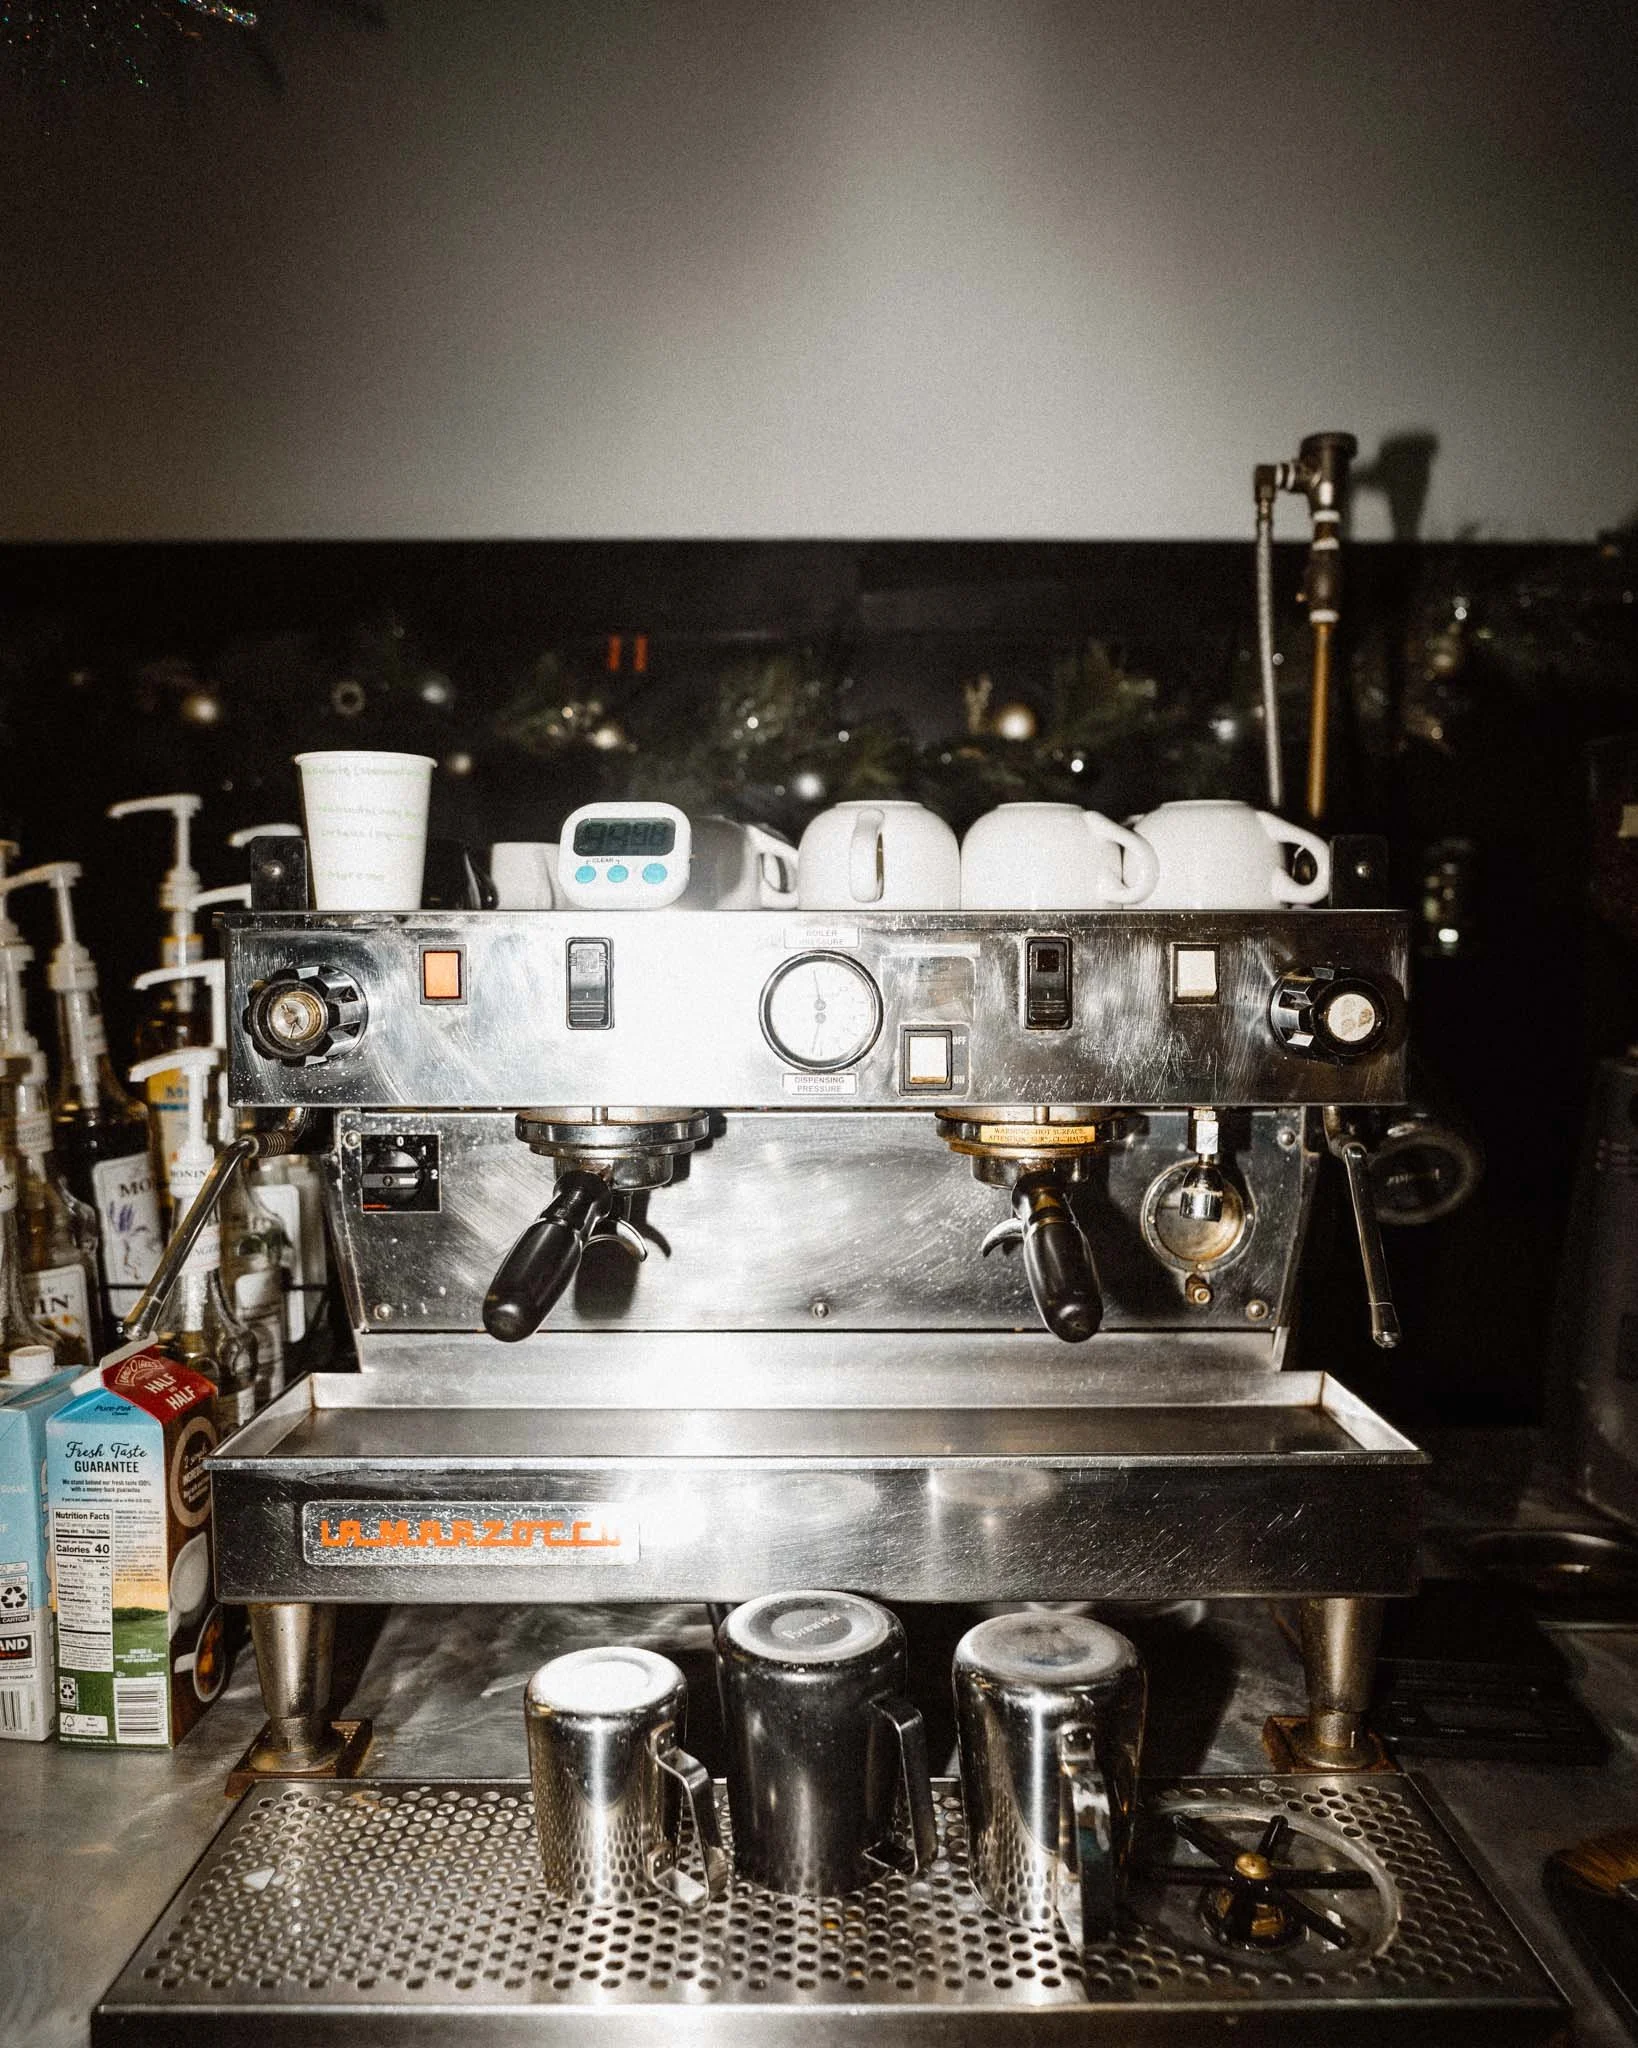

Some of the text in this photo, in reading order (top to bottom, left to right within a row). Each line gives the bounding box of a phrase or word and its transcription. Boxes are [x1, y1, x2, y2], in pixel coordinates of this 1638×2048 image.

[953, 1035, 967, 1045] OFF
[794, 1075, 845, 1084] DISPENSING
[953, 1075, 965, 1084] ON
[797, 1085, 842, 1093] PRESSURE
[396, 1135, 405, 1147] 0
[420, 1145, 427, 1156] 1
[430, 1168, 439, 1180] 2
[144, 1372, 177, 1395] HALF
[165, 1385, 197, 1411] HALF
[65, 1441, 148, 1459] Fresh Taste
[74, 1460, 140, 1473] GUARANTEE
[55, 1511, 110, 1520] Nutrition Facts
[56, 1543, 110, 1554] Calories 40
[2, 1616, 28, 1624] CARTON
